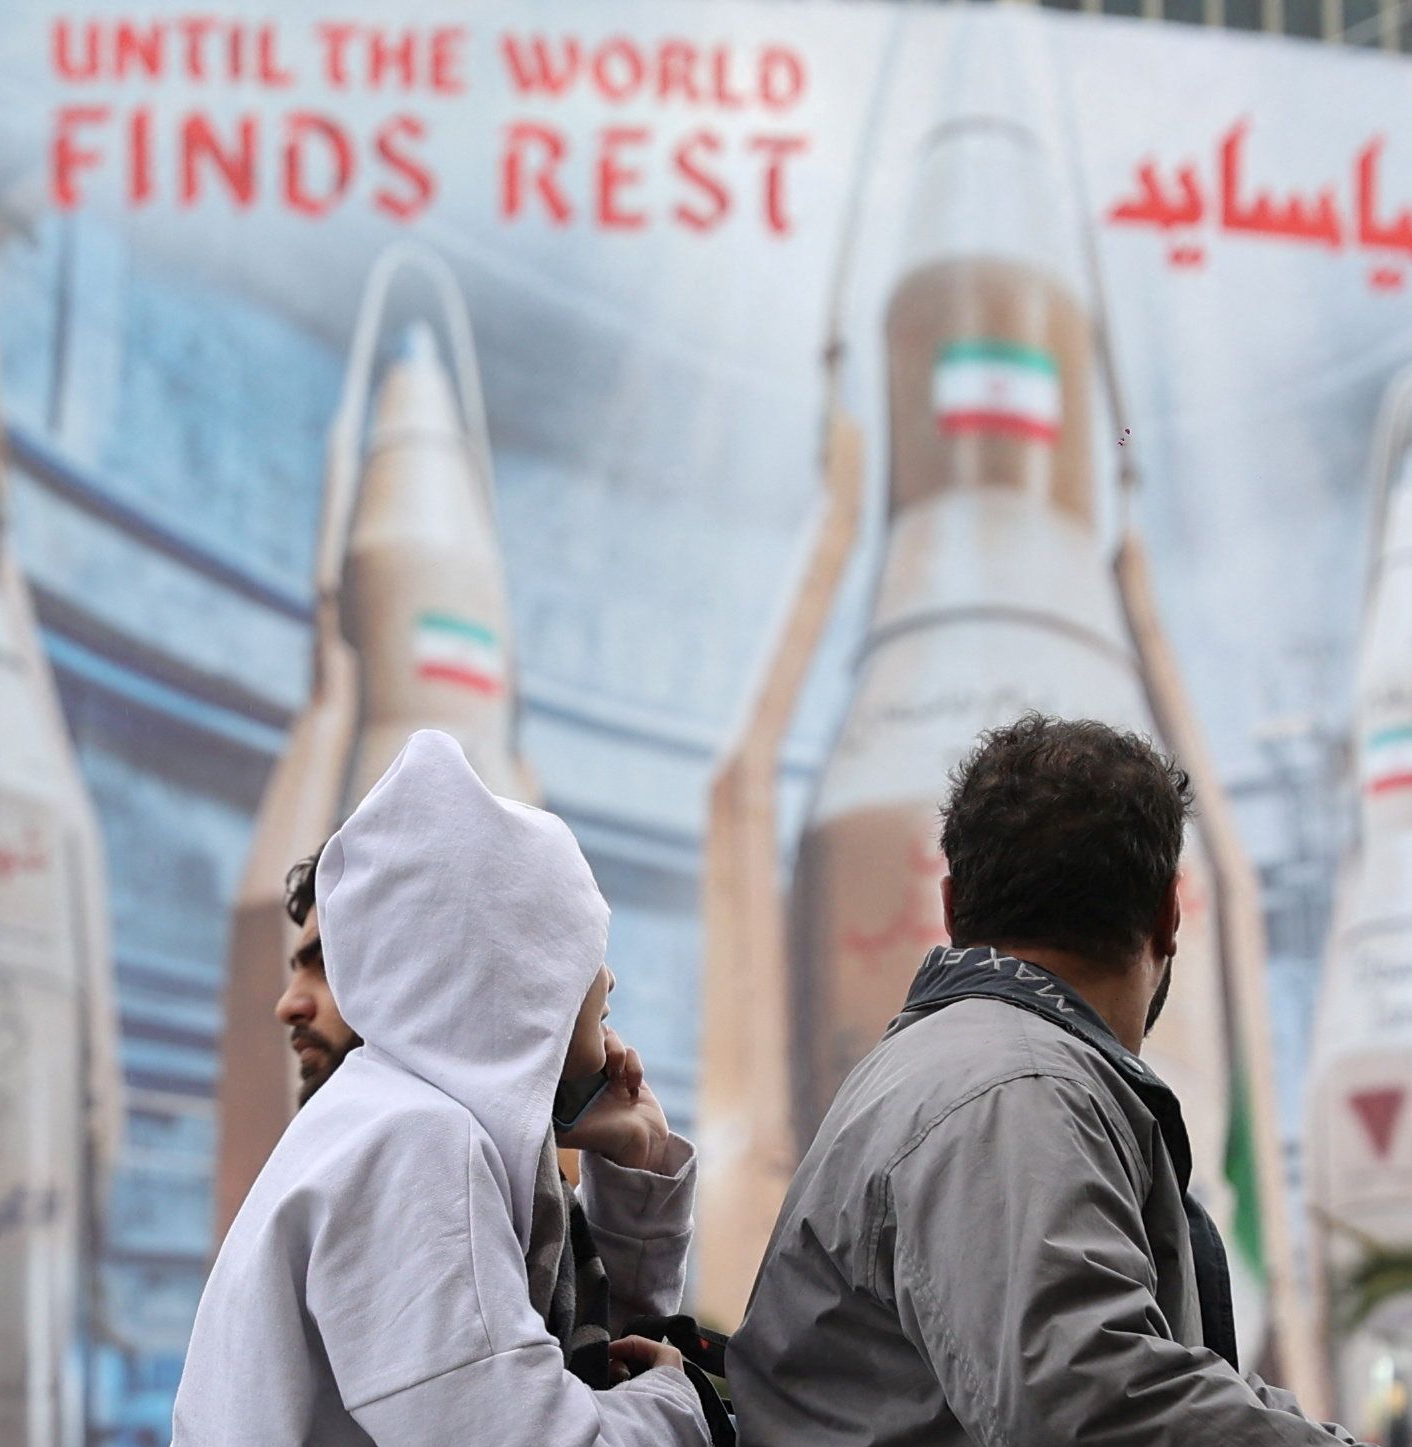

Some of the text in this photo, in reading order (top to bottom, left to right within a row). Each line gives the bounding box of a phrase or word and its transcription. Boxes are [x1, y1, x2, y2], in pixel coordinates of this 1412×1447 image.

[50, 17, 808, 112] UNTIL THE WORLD
[48, 105, 810, 237] FINDS REST
[977, 946, 1076, 1014] MAX
